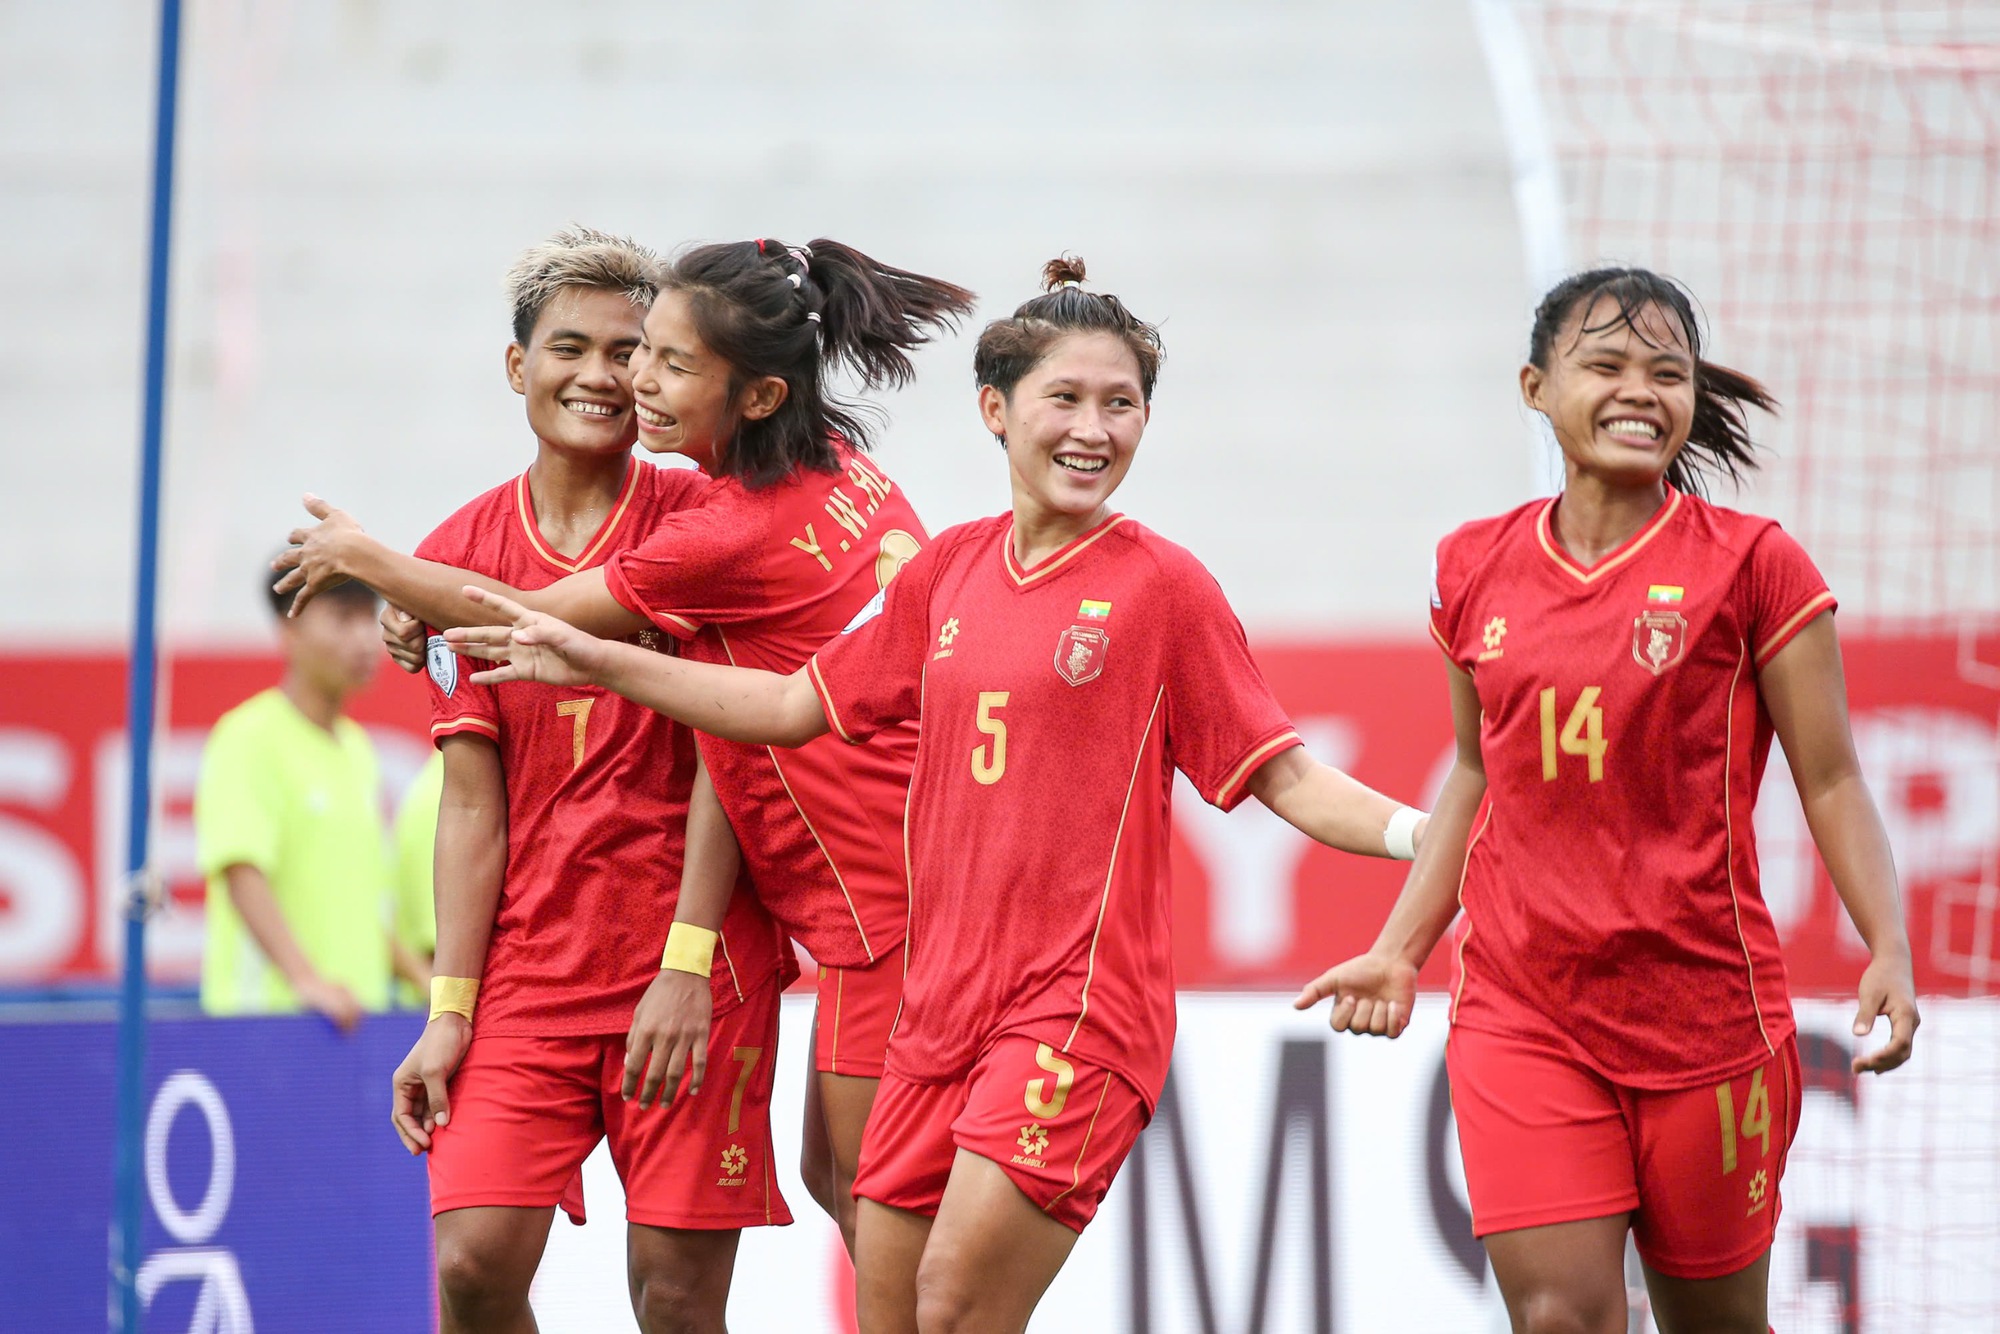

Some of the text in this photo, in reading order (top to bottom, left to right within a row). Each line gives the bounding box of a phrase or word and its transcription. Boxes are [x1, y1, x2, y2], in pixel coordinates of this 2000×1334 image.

[557, 697, 595, 770] 7
[970, 691, 1010, 785] 5
[1540, 685, 1608, 783] 14
[728, 1046, 763, 1135] 7
[1024, 1042, 1075, 1120] 5
[1715, 1065, 1772, 1176] 14
